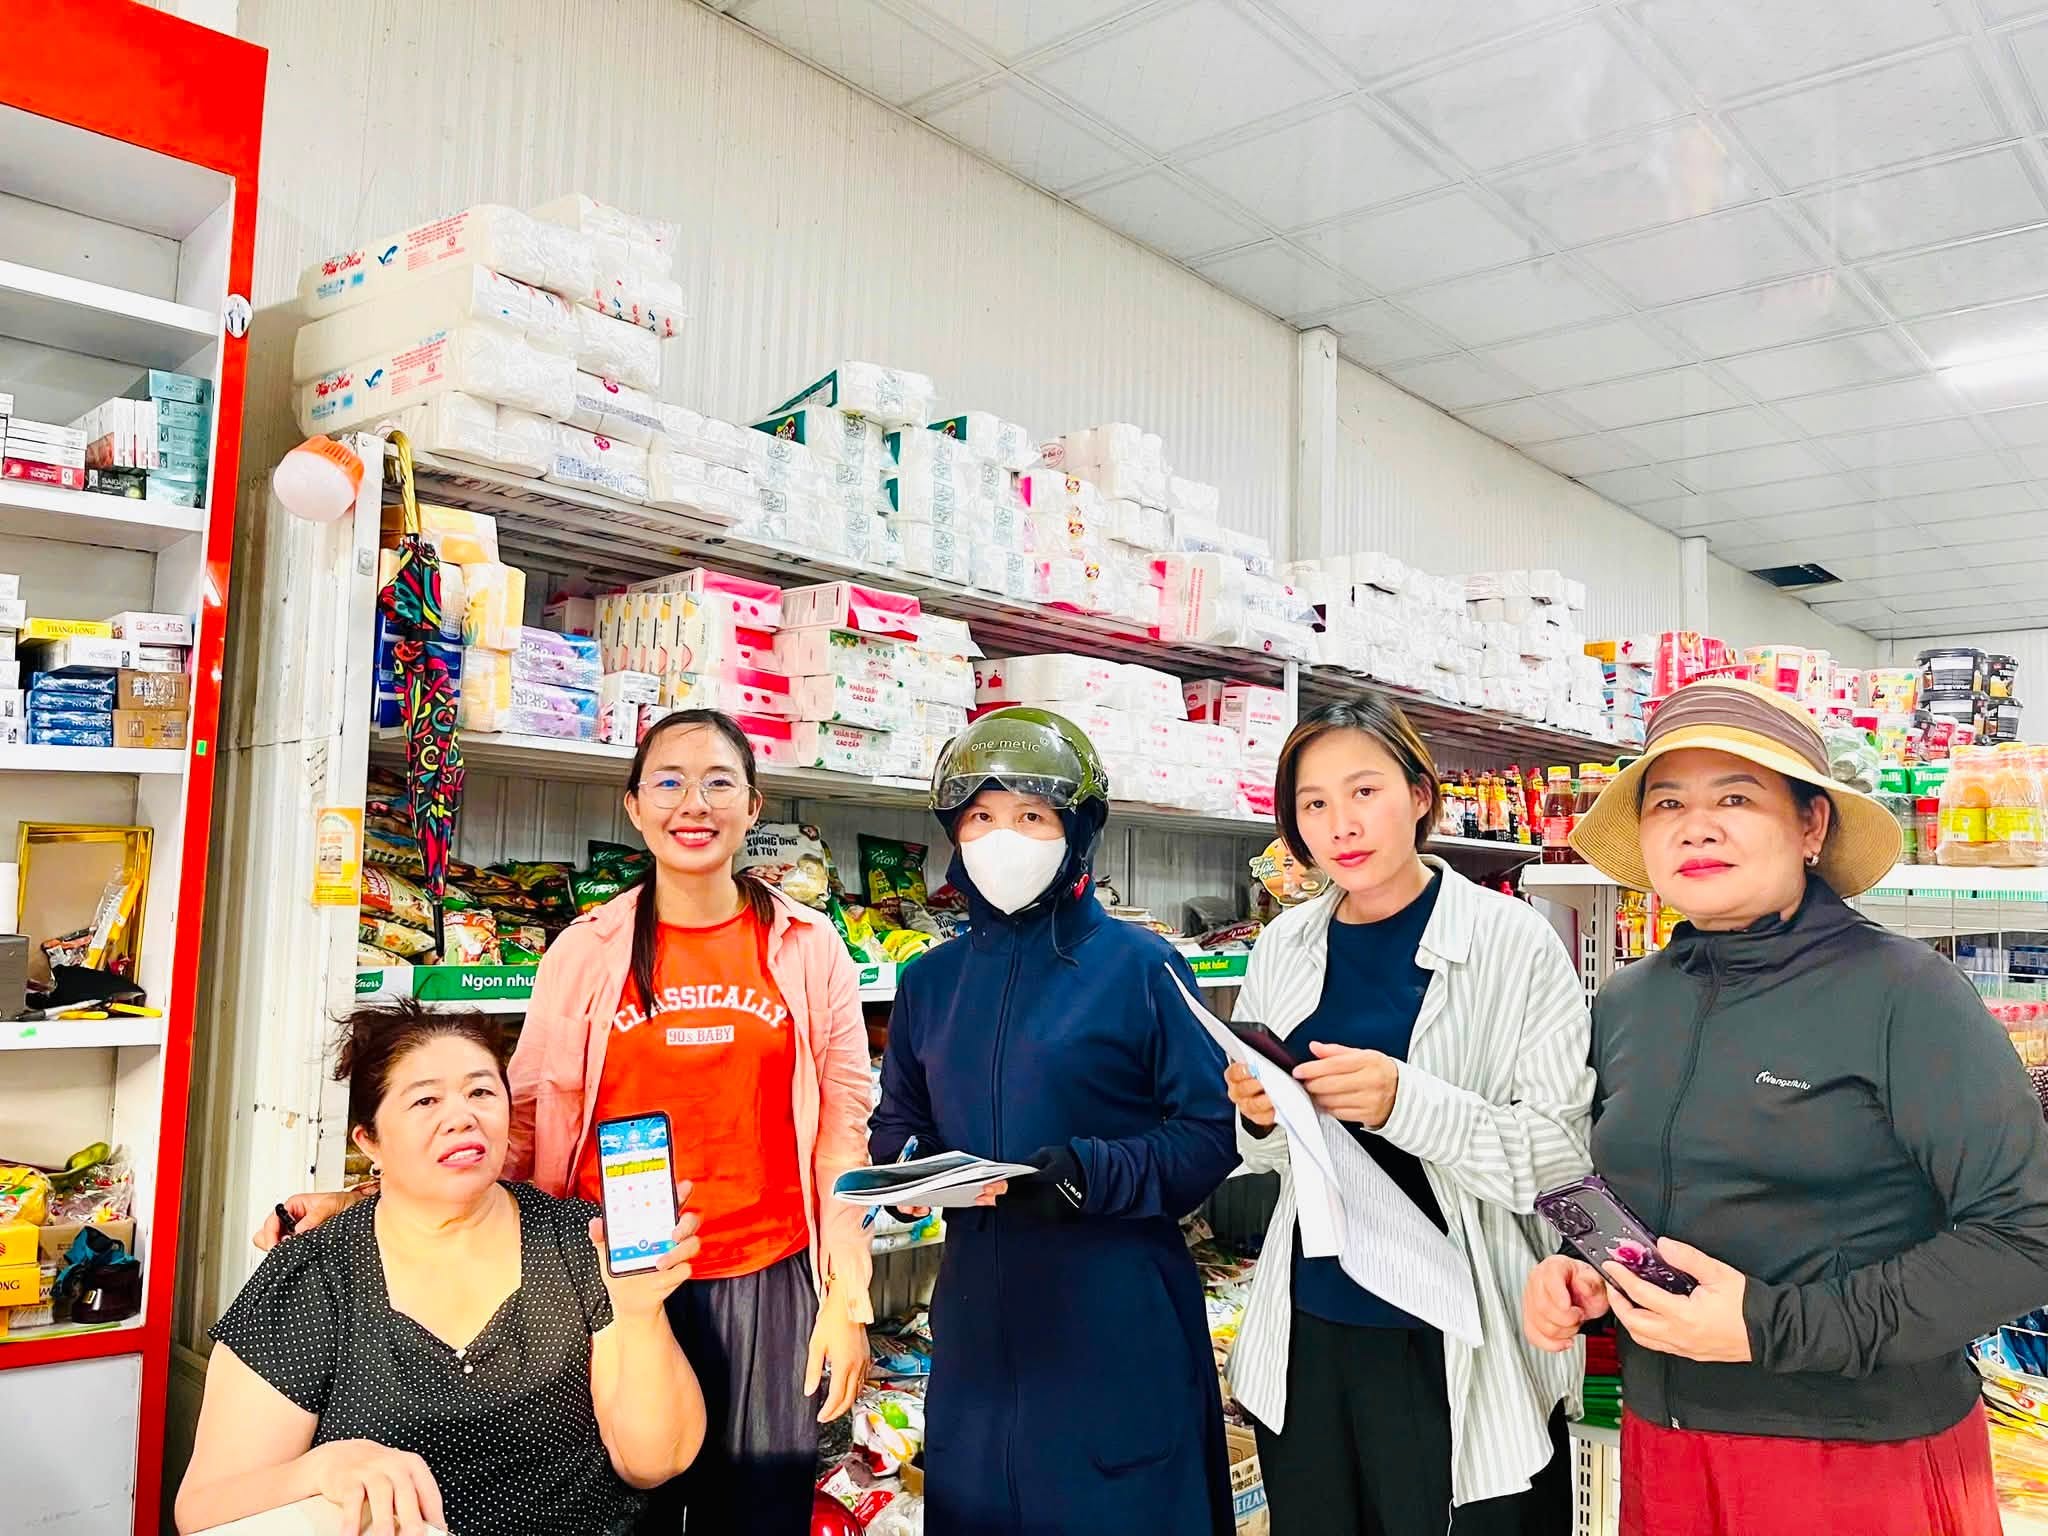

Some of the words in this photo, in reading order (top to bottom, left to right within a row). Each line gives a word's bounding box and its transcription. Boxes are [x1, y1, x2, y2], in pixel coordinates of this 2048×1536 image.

[102, 477, 130, 487] SAIGON
[971, 740, 995, 752] one
[461, 973, 503, 991] Ngon
[613, 984, 788, 1033] CLASSICALLY
[668, 1030, 693, 1043] 90s
[697, 1028, 732, 1042] BABY
[0, 1280, 20, 1291] NG
